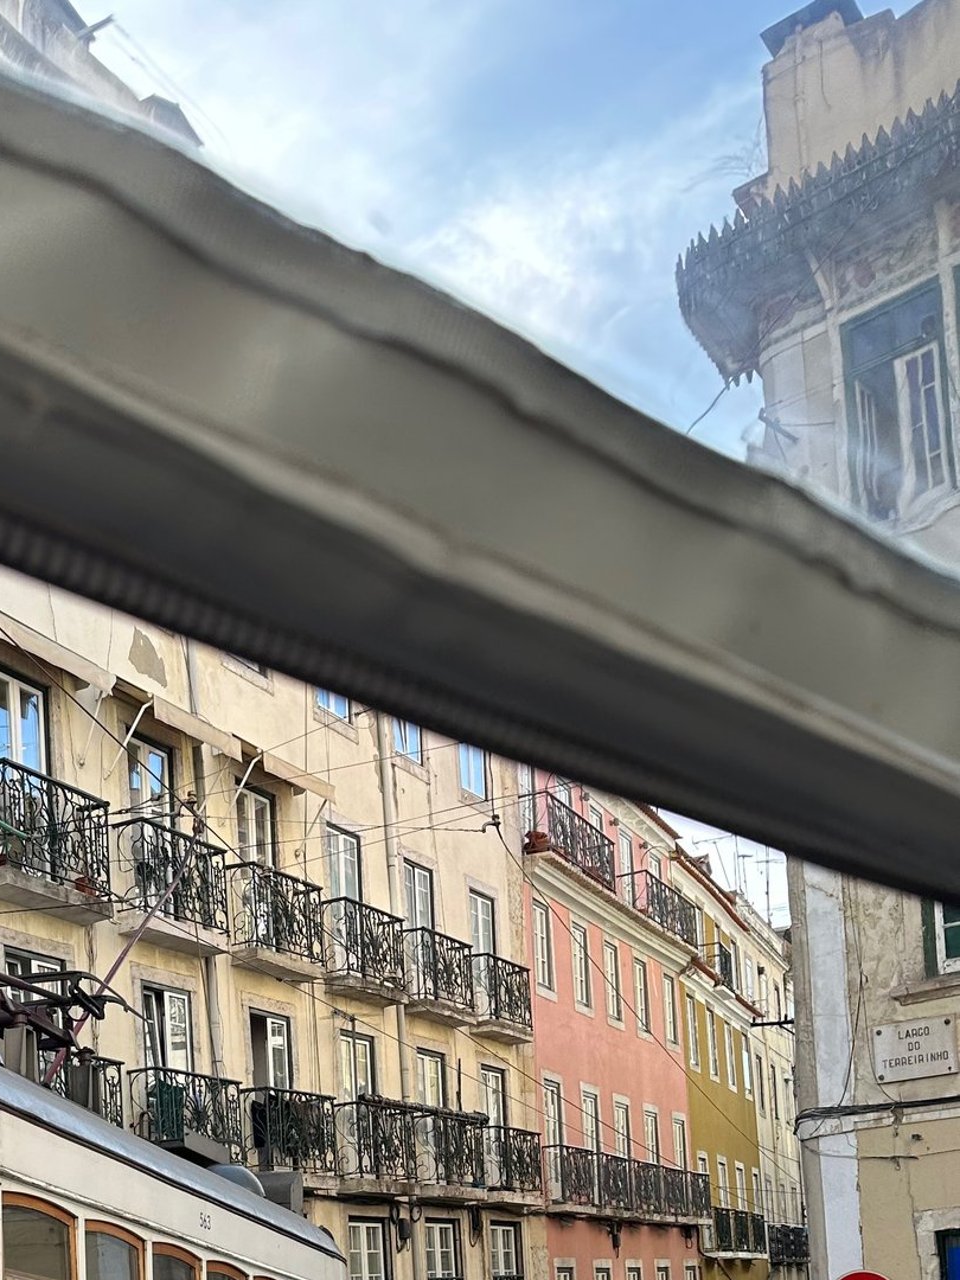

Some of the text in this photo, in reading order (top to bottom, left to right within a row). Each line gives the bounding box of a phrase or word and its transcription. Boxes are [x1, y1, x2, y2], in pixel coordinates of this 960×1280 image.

[897, 1025, 930, 1040] LARGO
[907, 1041, 921, 1052] DO
[881, 1050, 950, 1069] TERREIRINHO
[199, 1211, 211, 1231] 563
